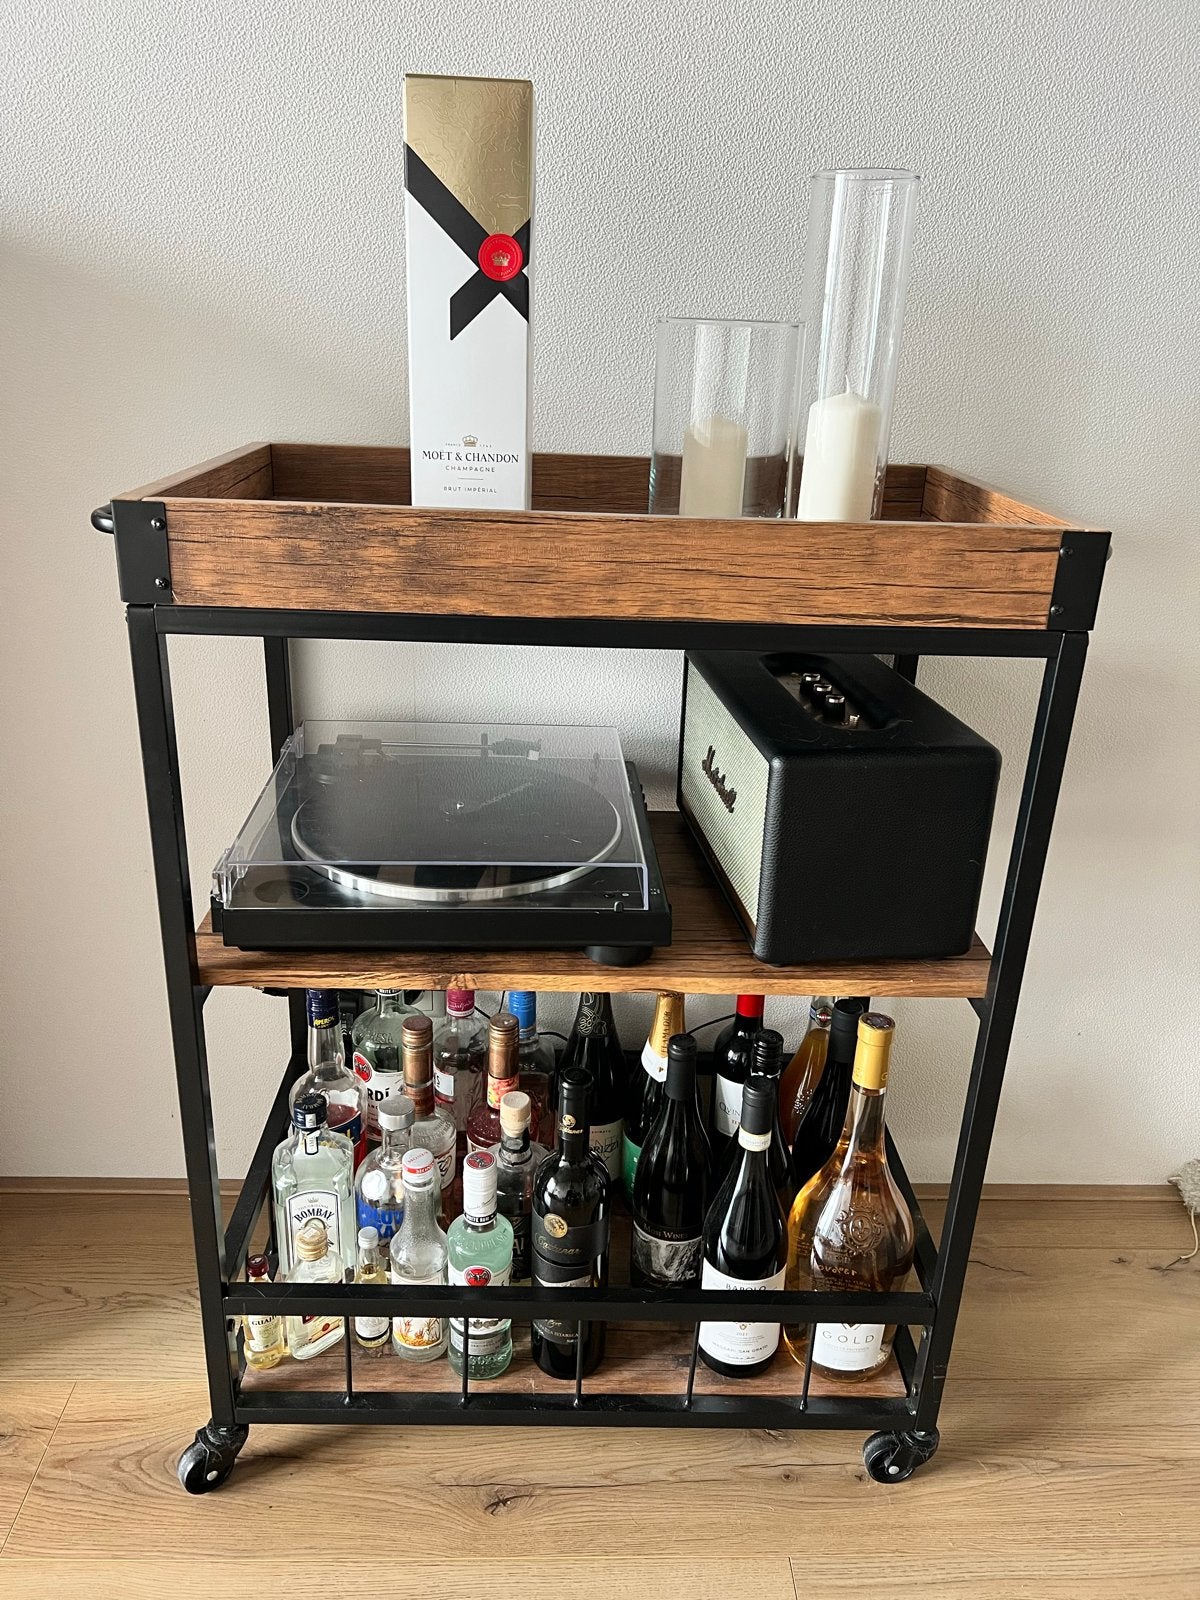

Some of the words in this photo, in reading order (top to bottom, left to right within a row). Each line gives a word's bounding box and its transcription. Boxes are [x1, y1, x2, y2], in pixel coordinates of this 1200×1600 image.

[455, 453, 463, 462] &
[465, 452, 519, 463] CHANDON
[445, 465, 496, 473] CHAMPAGNE
[293, 1208, 335, 1223] BOMBAY
[822, 1330, 875, 1345] GOLD
